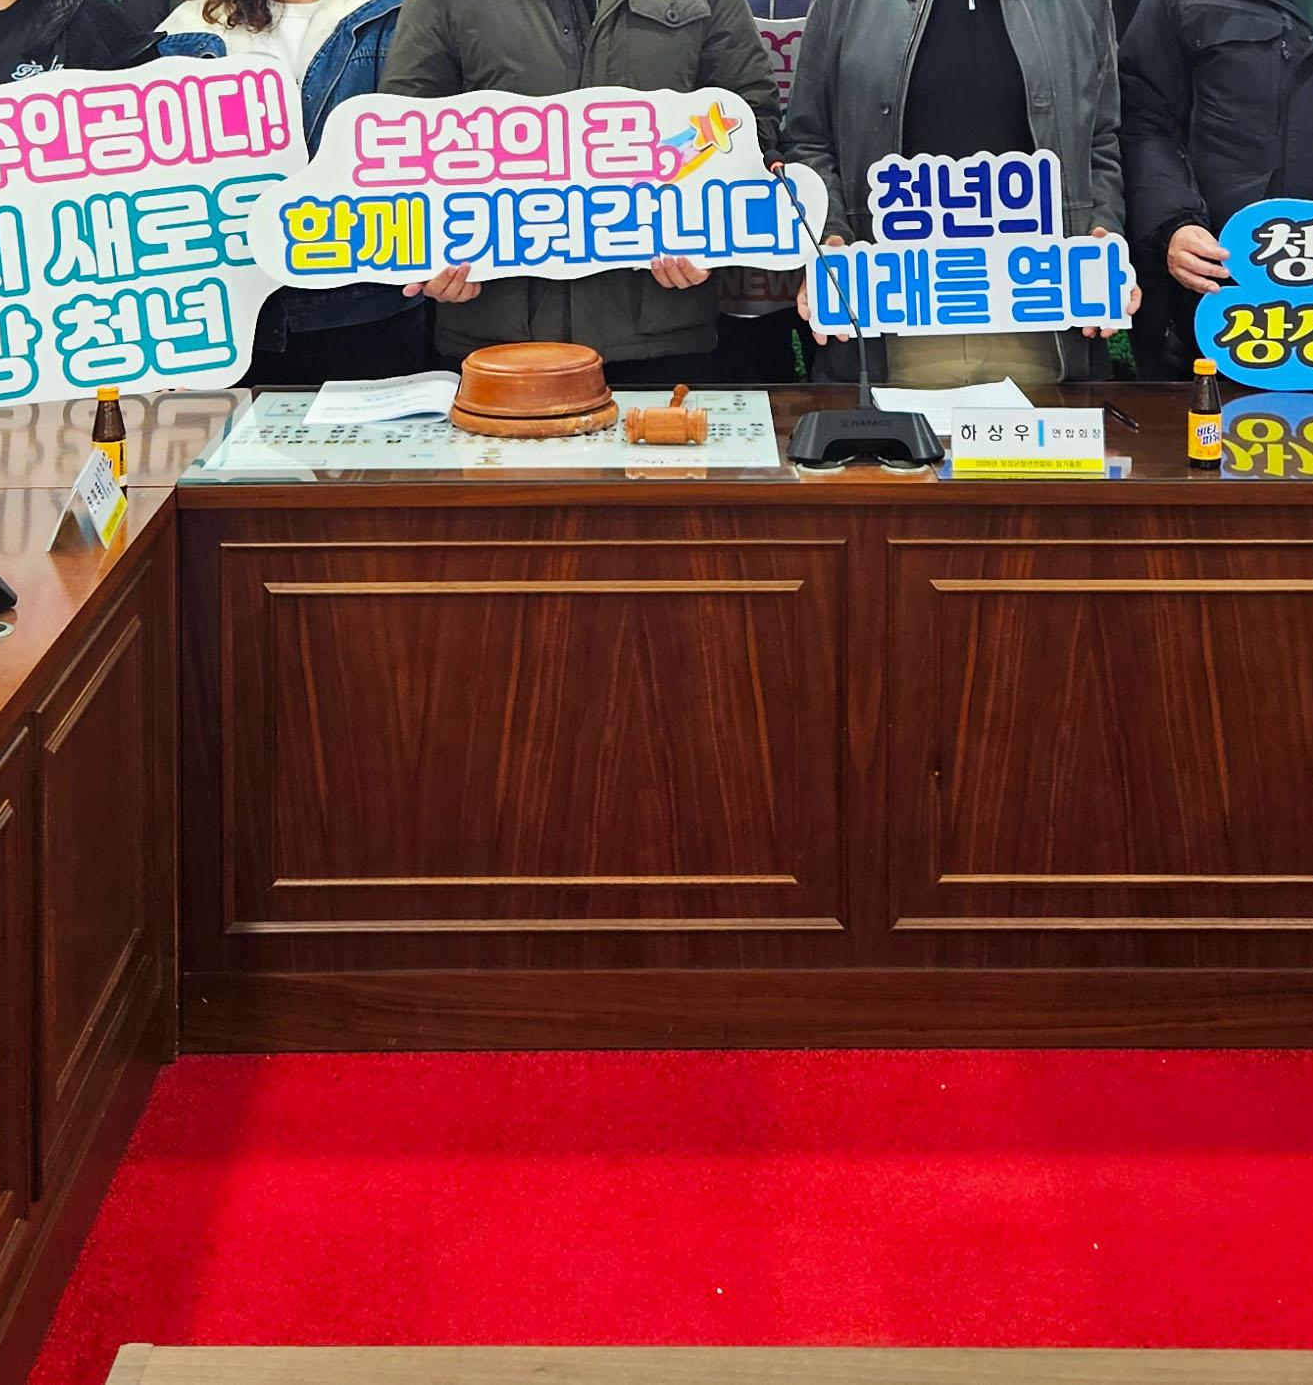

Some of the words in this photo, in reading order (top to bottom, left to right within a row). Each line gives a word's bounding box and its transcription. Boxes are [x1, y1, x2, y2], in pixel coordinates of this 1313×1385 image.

[355, 100, 571, 187] 보성의
[281, 193, 433, 275] 함께
[444, 180, 808, 268] 키워갑니다
[875, 156, 1055, 240] 청년의
[813, 241, 992, 331] 미래를
[1008, 240, 1129, 323] 열다
[54, 277, 237, 390] 청년
